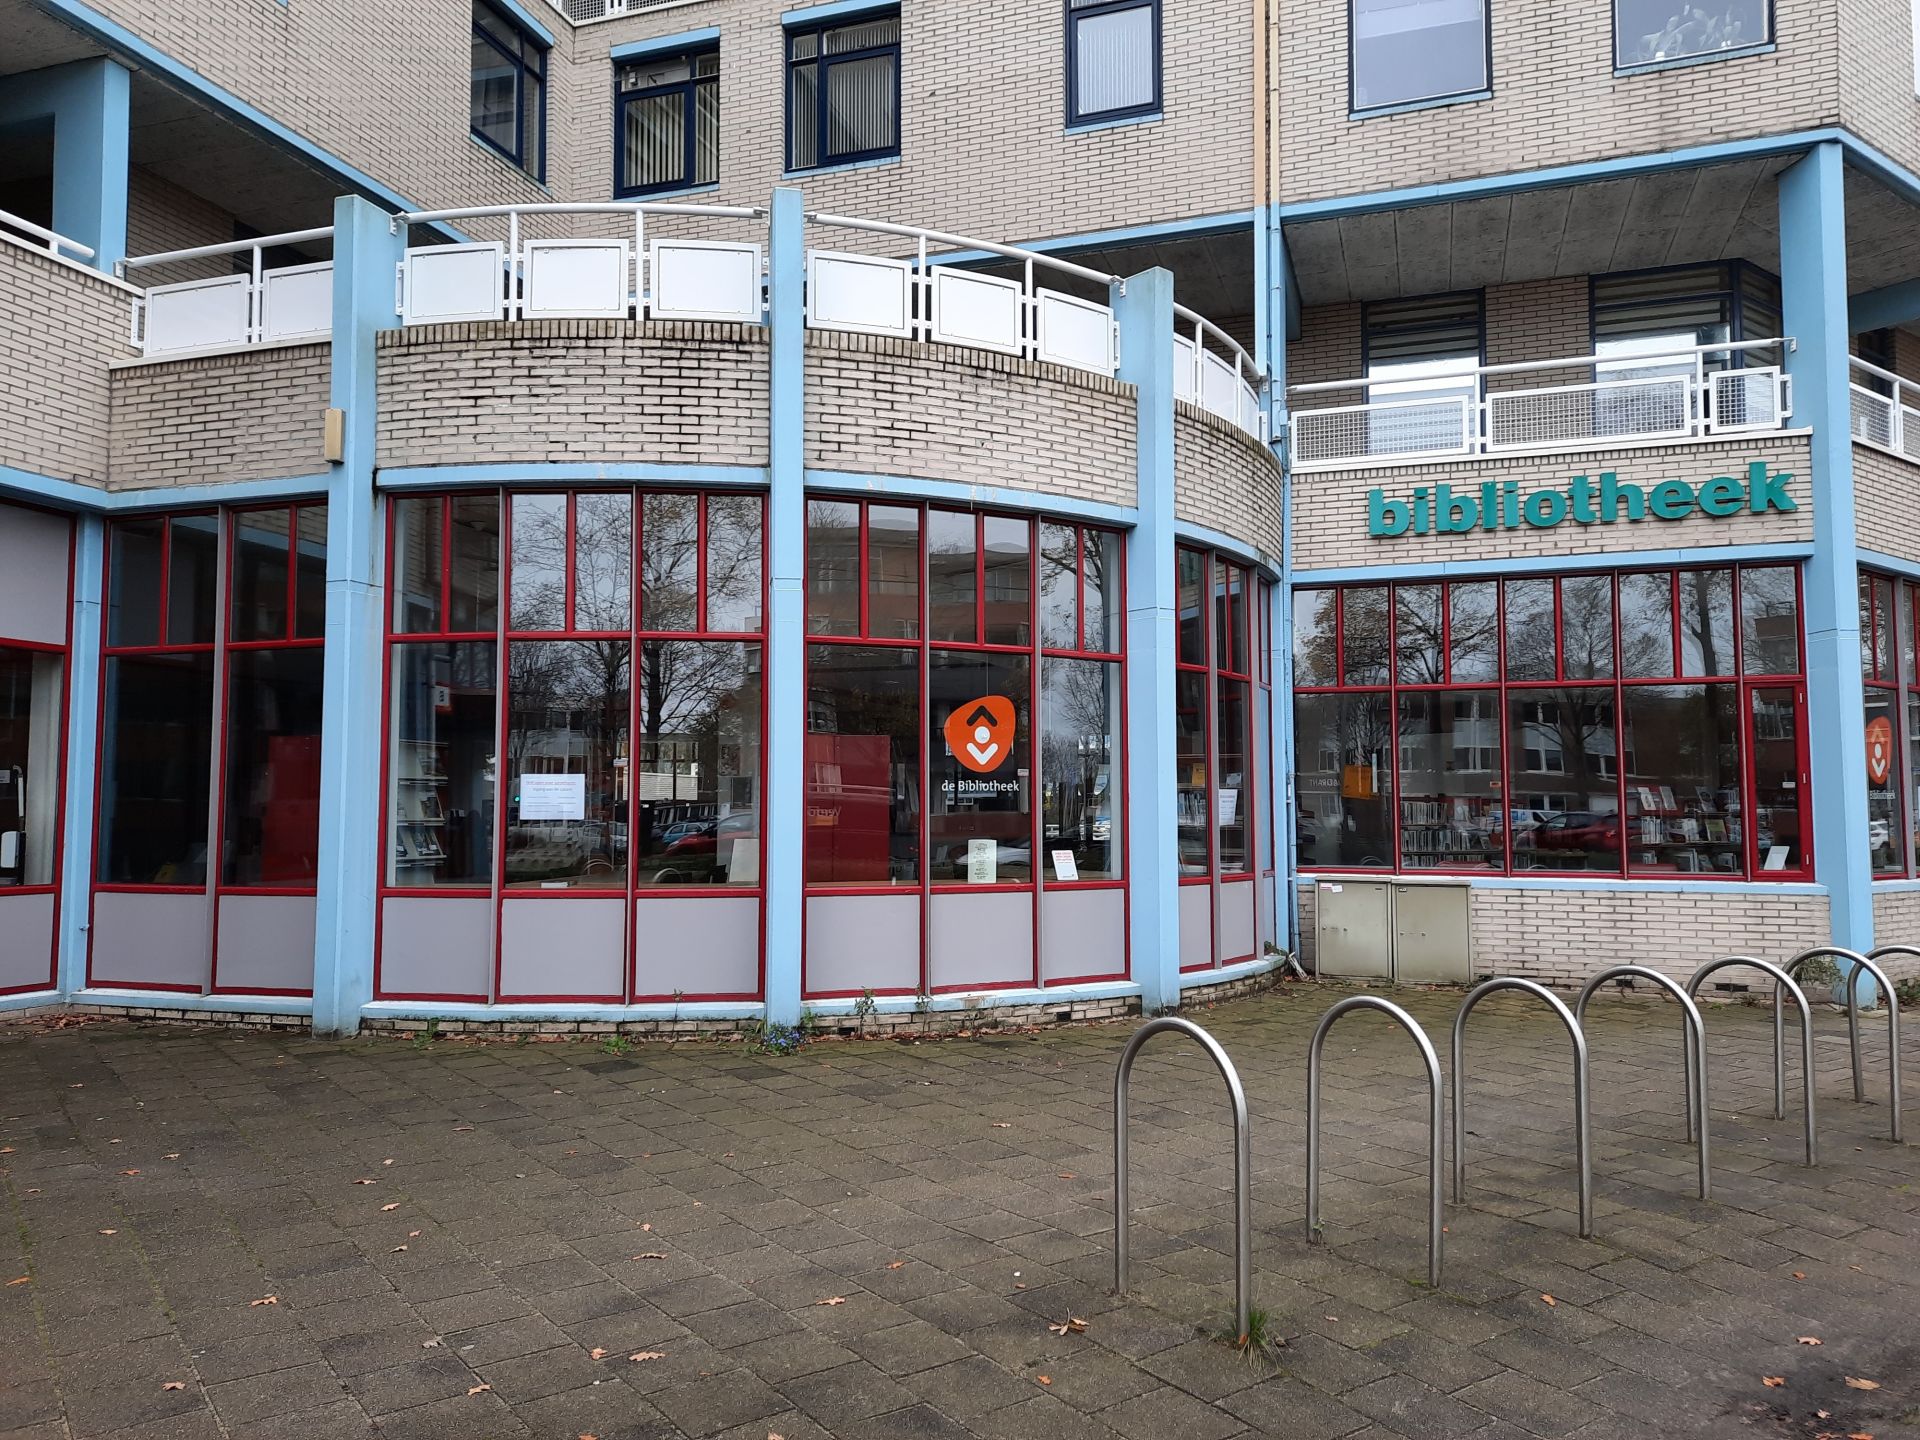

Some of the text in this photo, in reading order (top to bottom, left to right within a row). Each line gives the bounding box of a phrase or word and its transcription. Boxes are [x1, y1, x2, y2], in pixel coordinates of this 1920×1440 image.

[1368, 461, 1799, 536] bibliotheek
[941, 780, 1020, 792] de Bibliotheek
